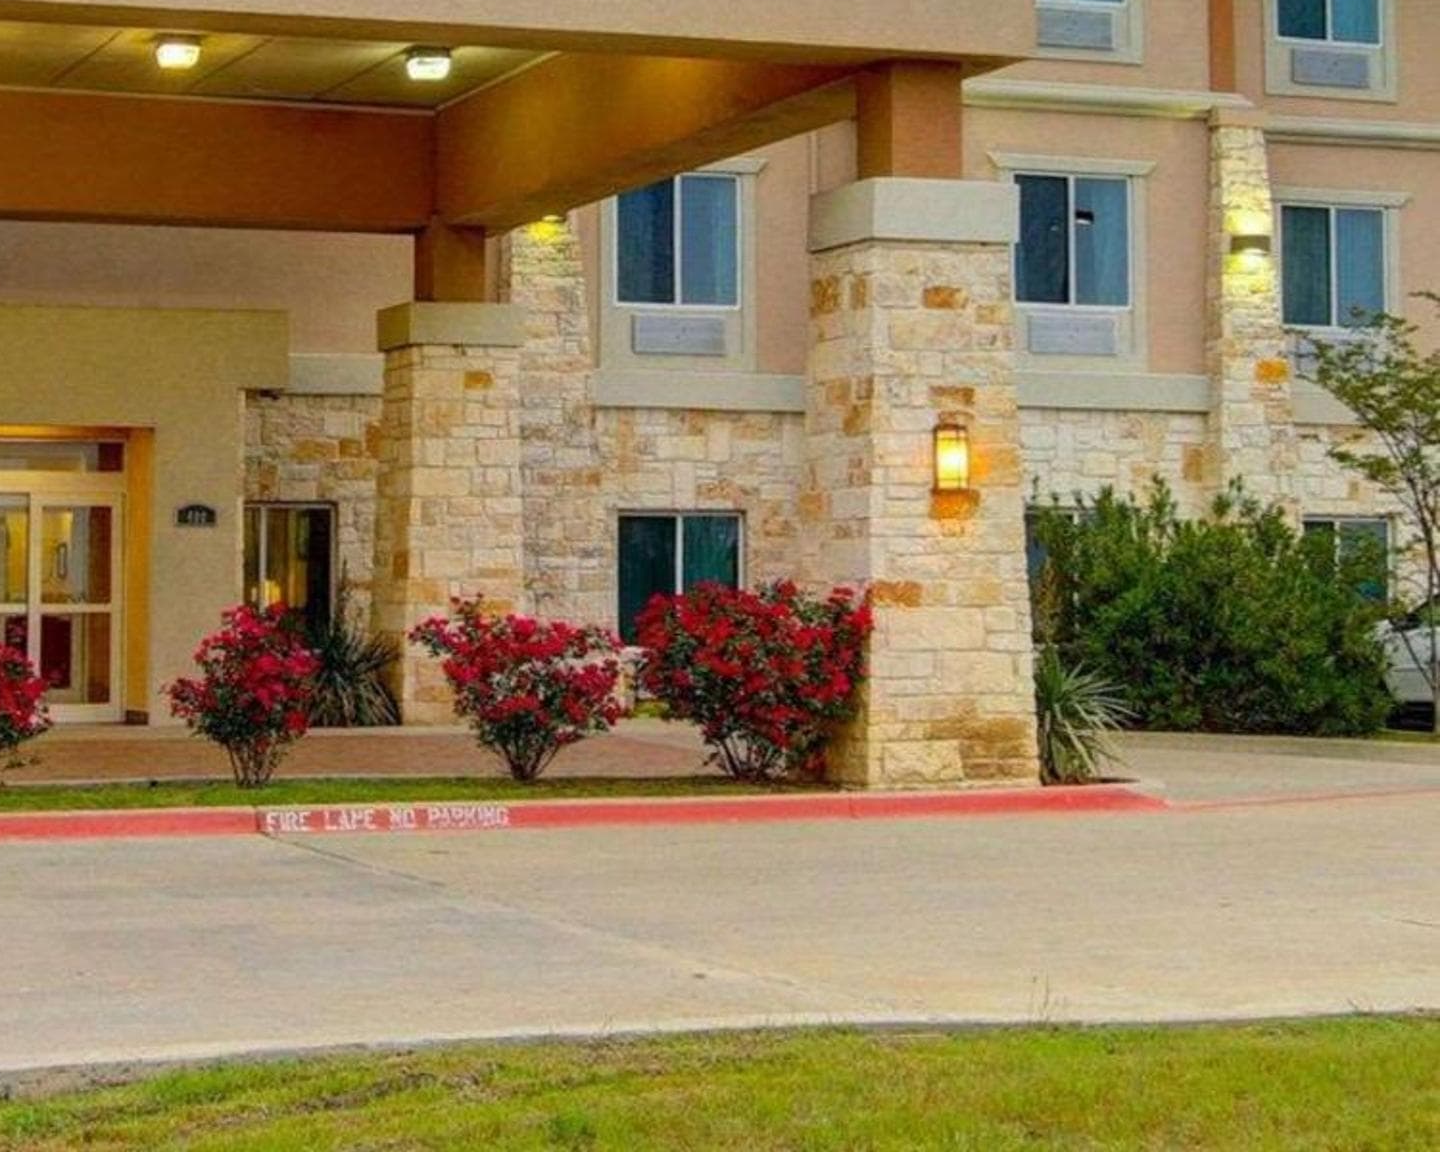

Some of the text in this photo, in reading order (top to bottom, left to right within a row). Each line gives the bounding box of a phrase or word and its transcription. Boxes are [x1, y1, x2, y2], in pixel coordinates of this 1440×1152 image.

[266, 811, 312, 832] FIRE
[388, 807, 416, 829] NO
[428, 805, 512, 828] PARKING
